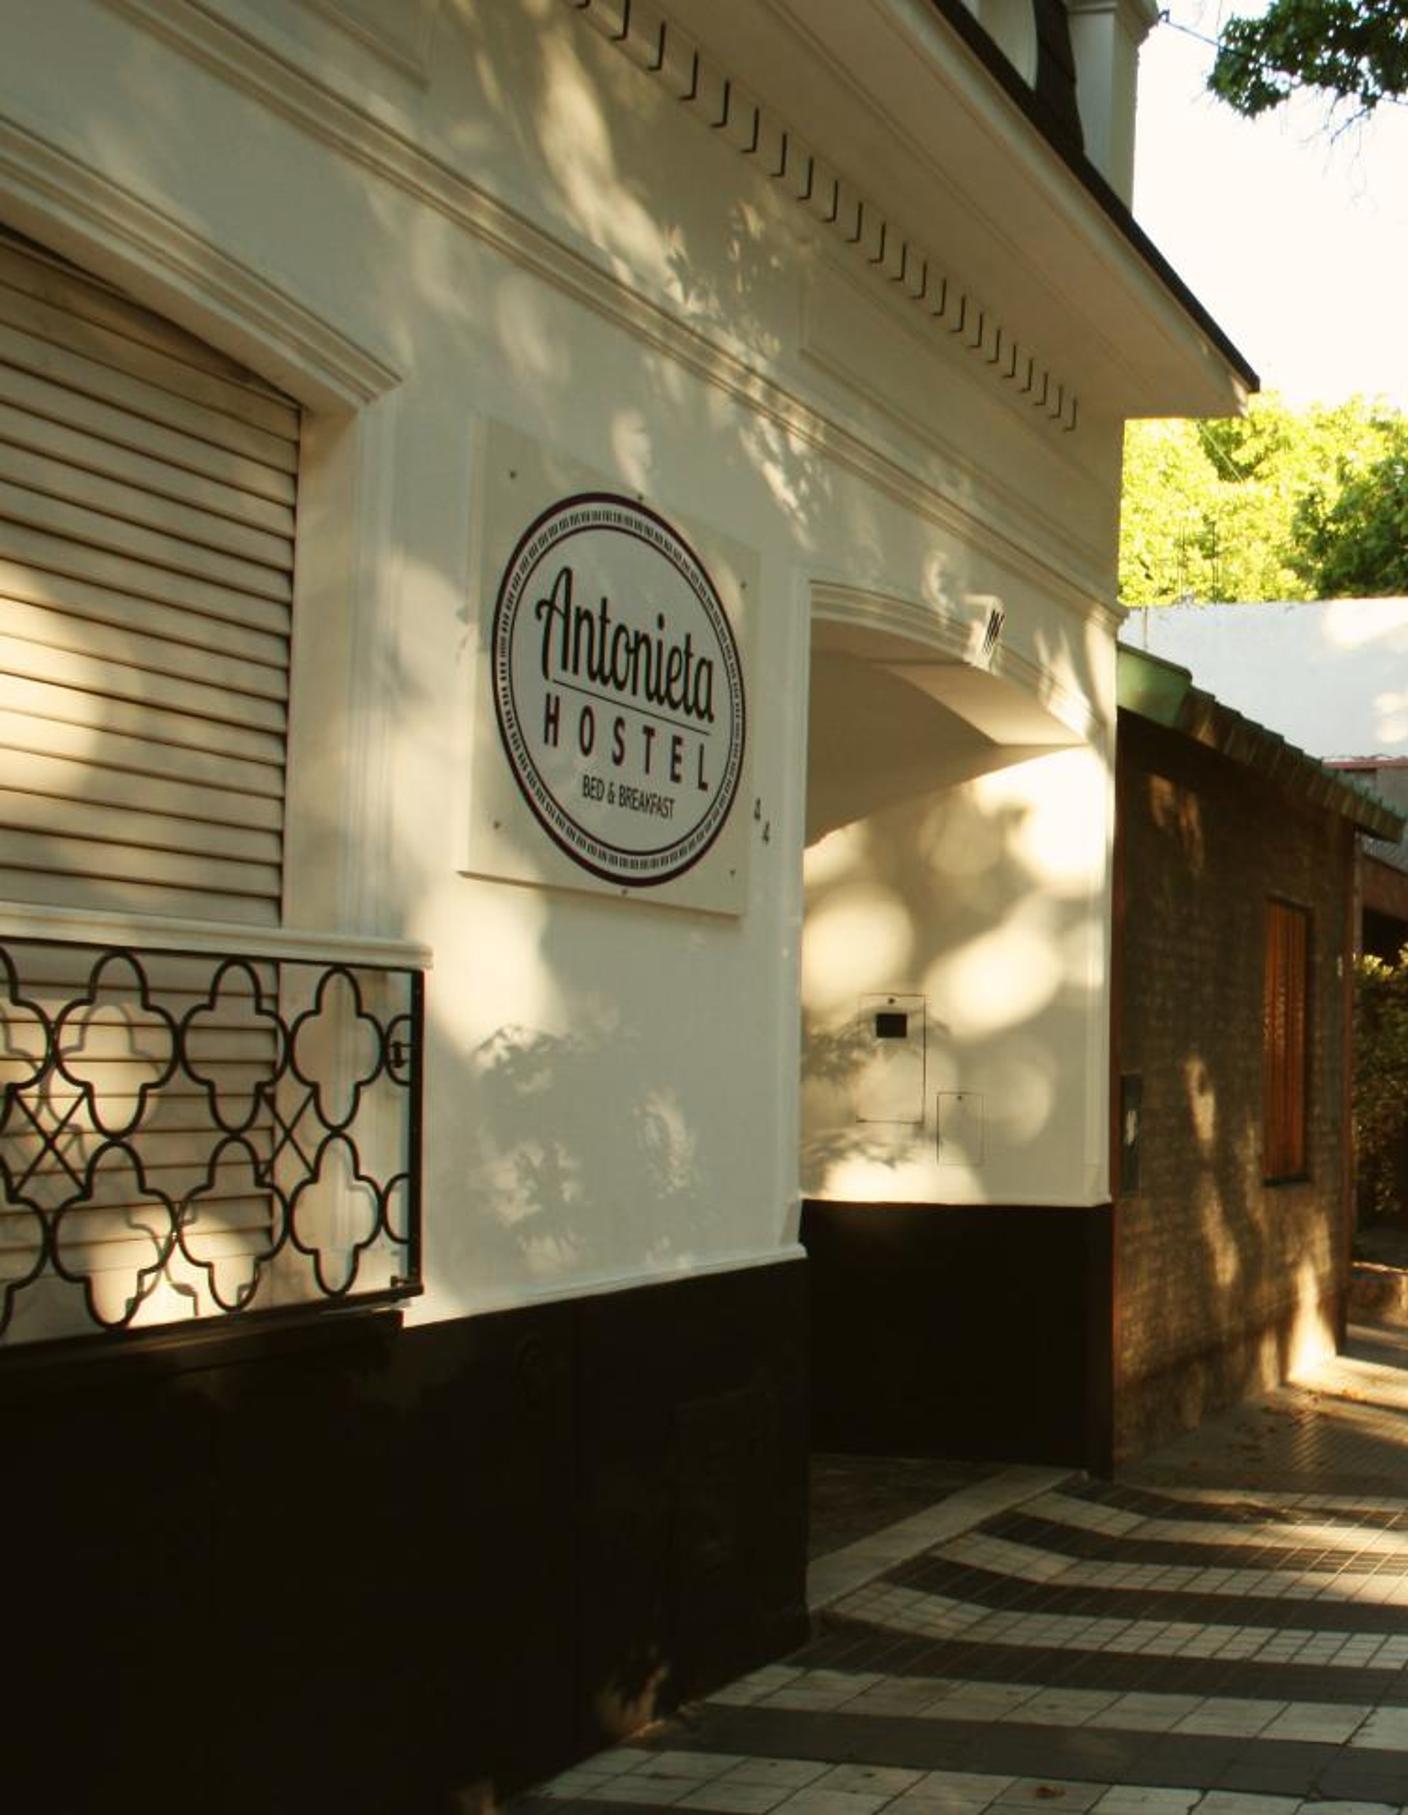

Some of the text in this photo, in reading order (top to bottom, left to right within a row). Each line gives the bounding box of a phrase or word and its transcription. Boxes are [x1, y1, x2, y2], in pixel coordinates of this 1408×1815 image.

[535, 566, 715, 723] Antonieta
[543, 691, 709, 791] HOSTEL
[583, 774, 675, 819] BED & BREAKFAST
